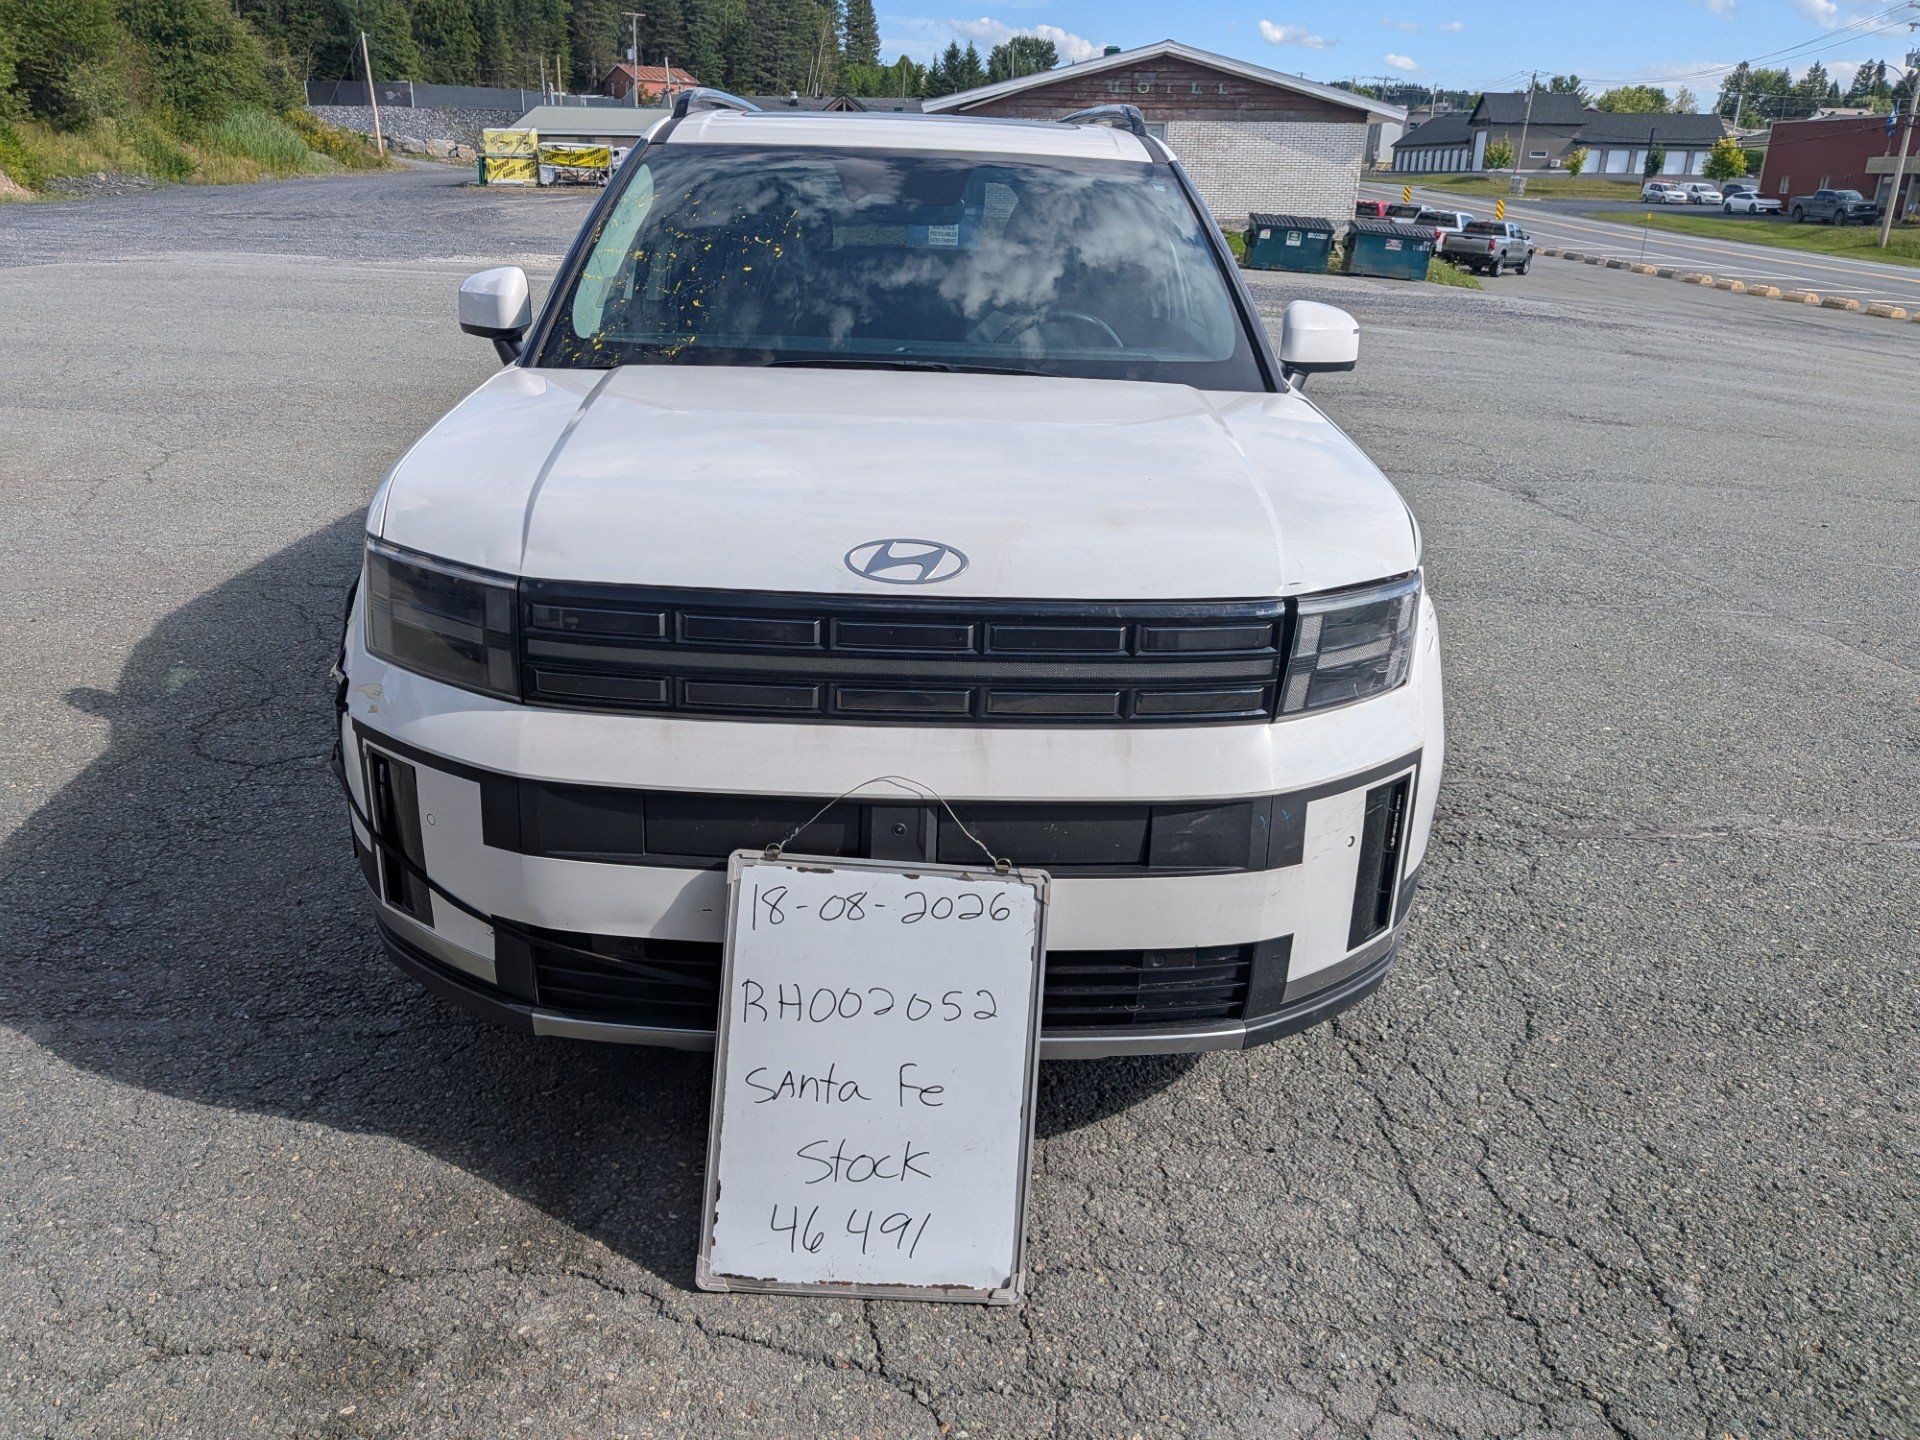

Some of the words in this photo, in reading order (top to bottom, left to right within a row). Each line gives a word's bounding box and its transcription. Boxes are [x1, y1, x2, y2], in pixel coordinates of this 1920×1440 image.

[752, 883, 1012, 932] 18-08-2026
[741, 978, 999, 1025] RH002052
[898, 1062, 946, 1109] Fe
